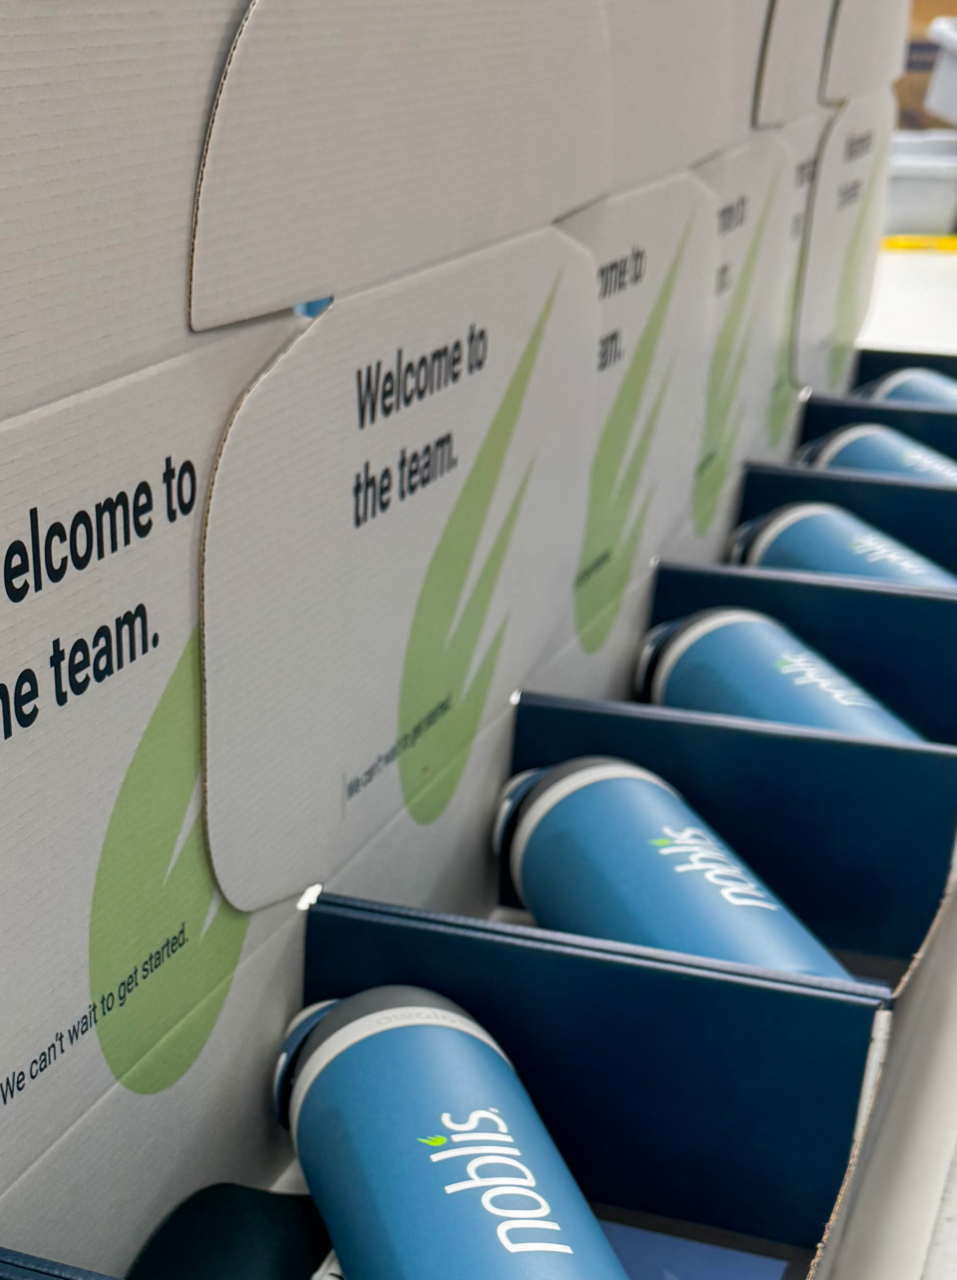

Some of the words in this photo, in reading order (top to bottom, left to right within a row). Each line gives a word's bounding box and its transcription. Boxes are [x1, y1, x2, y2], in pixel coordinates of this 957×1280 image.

[356, 338, 462, 430] Welcome
[467, 323, 488, 375] to
[163, 456, 197, 523] to
[353, 460, 392, 528] the
[398, 430, 459, 501] team.
[50, 603, 159, 706] team.
[0, 1070, 26, 1105] We
[67, 1003, 98, 1046] wait
[99, 991, 115, 1017] to
[118, 966, 140, 1007] get
[142, 922, 190, 980] started.
